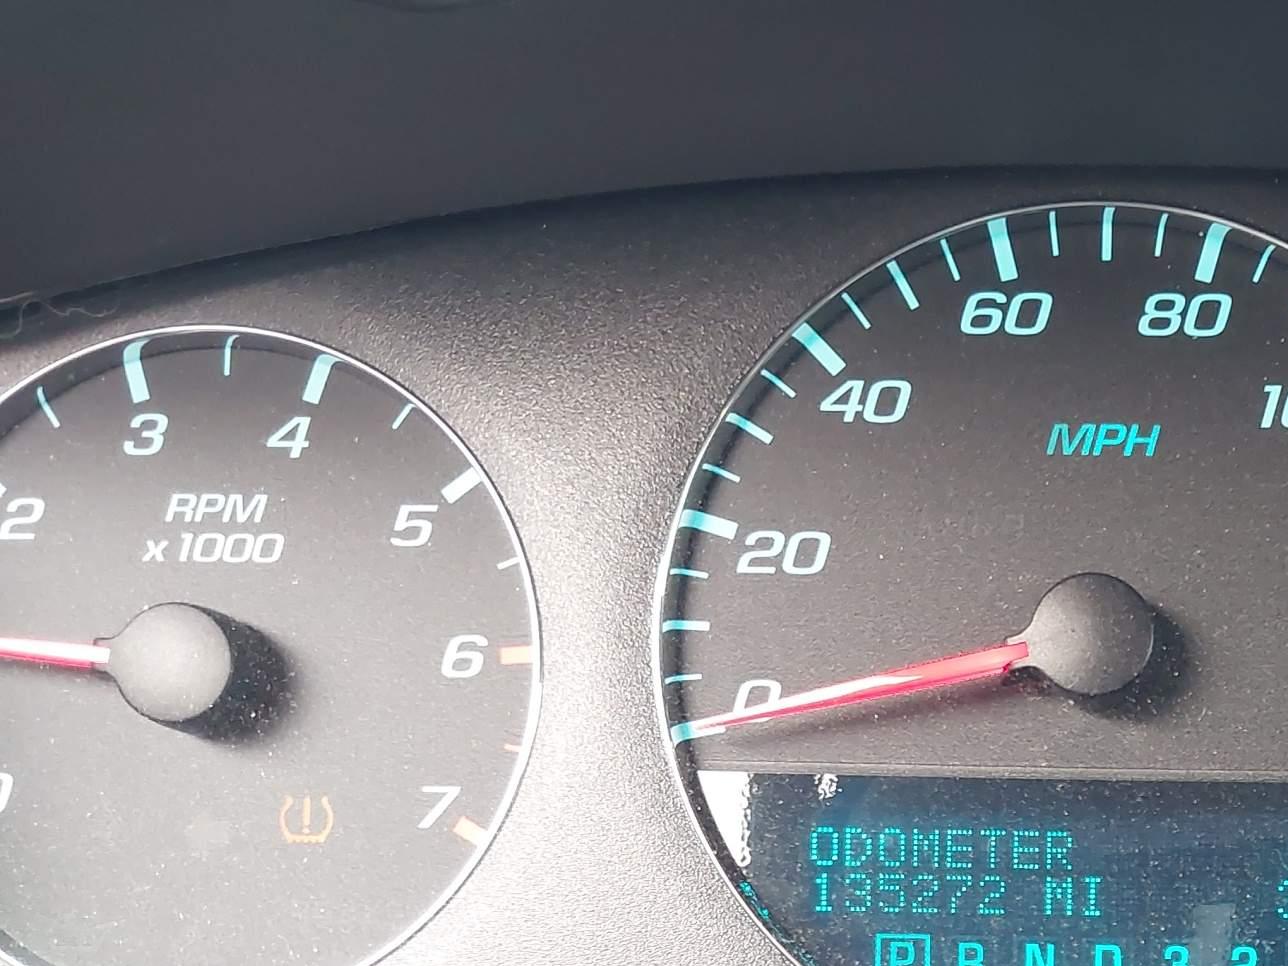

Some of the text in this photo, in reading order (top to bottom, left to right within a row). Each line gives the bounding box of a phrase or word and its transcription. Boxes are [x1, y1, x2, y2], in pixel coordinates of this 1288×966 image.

[960, 291, 1053, 336] 60
[1138, 292, 1233, 338] 80
[819, 379, 912, 424] 40
[123, 413, 168, 456] 3
[267, 416, 310, 458] 4
[1046, 423, 1161, 457] MPH
[0, 497, 46, 540] 2
[165, 493, 268, 523] RPM
[390, 504, 439, 547] 5
[735, 530, 832, 576] 20
[441, 634, 489, 678] 6
[417, 786, 461, 829] 7
[809, 826, 1074, 871] ODOMETER
[815, 872, 1104, 918] 135272 MI
